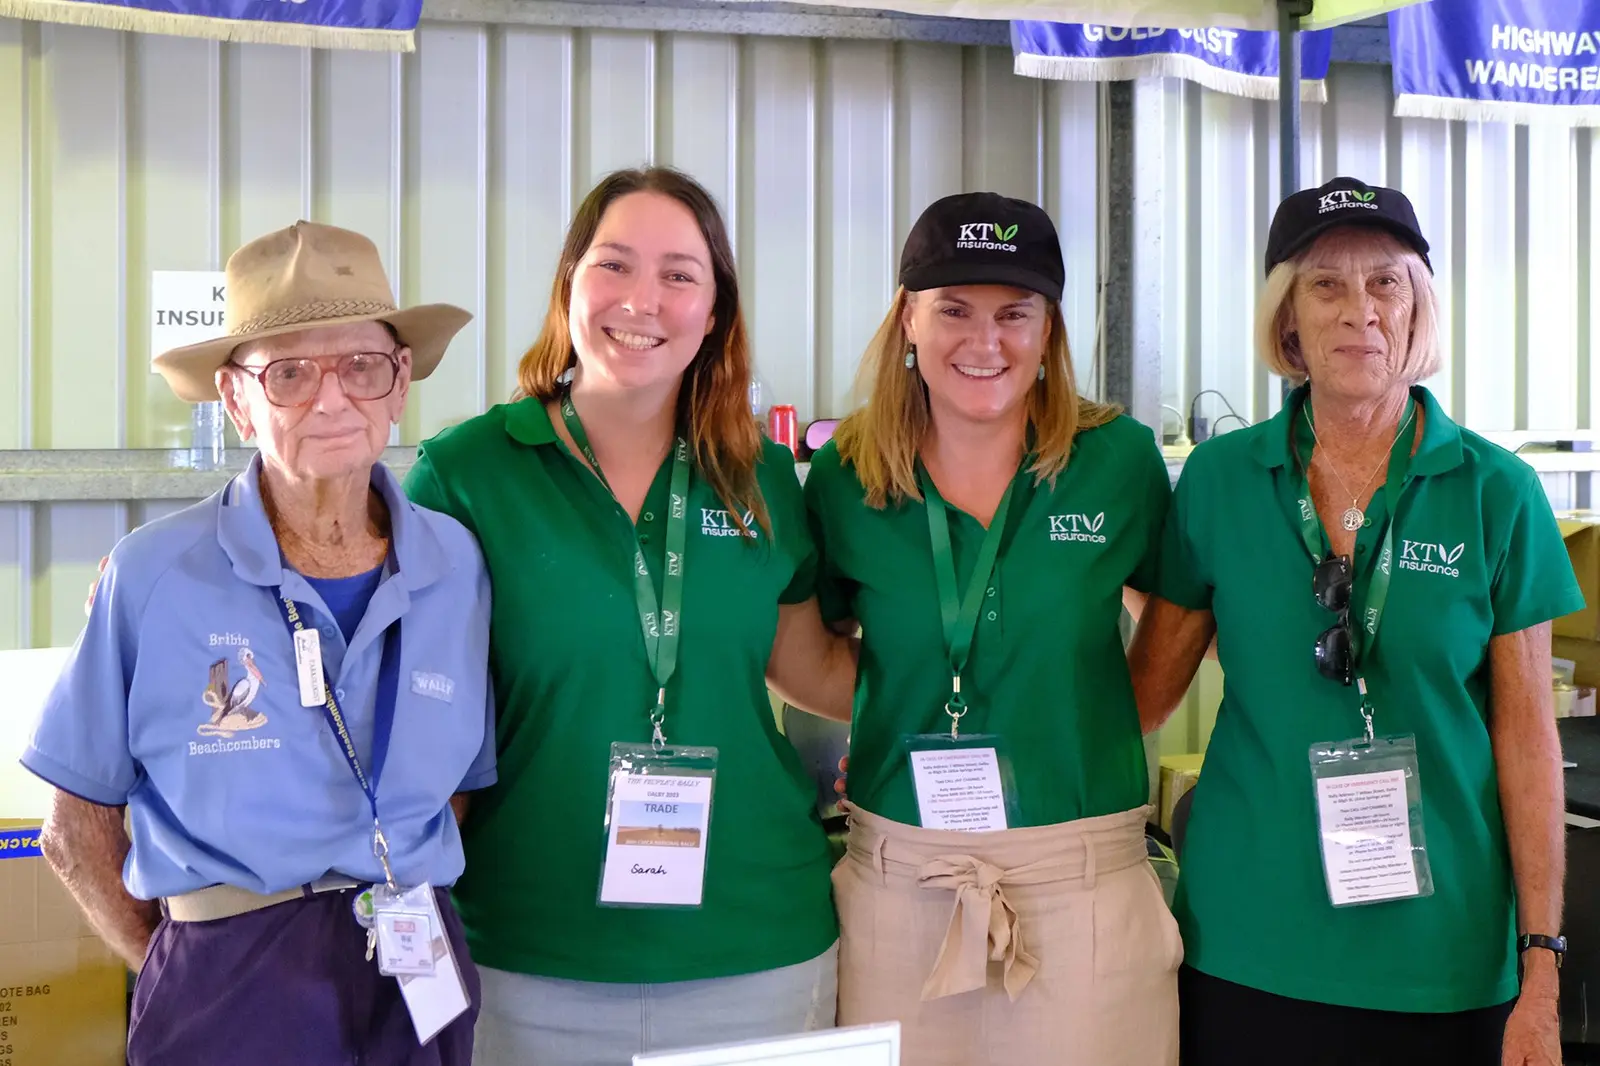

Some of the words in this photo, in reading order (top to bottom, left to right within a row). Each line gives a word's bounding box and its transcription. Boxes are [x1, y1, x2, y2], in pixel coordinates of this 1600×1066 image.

[1465, 59, 1600, 92] WANDERE
[1318, 190, 1352, 209] KT
[1318, 202, 1379, 214] insurance
[958, 223, 994, 241] KT
[957, 241, 1017, 252] insurance
[700, 508, 731, 528] KT
[1048, 514, 1083, 533] KT
[1049, 532, 1106, 543] insurance
[1400, 539, 1437, 563] KT
[1399, 560, 1459, 578] insurance
[209, 632, 250, 646] Bribie
[188, 736, 281, 755] Beachcombers
[644, 803, 679, 814] TRADE
[631, 864, 667, 875] Sarah
[0, 988, 22, 998] OTE
[26, 984, 51, 996] BAG
